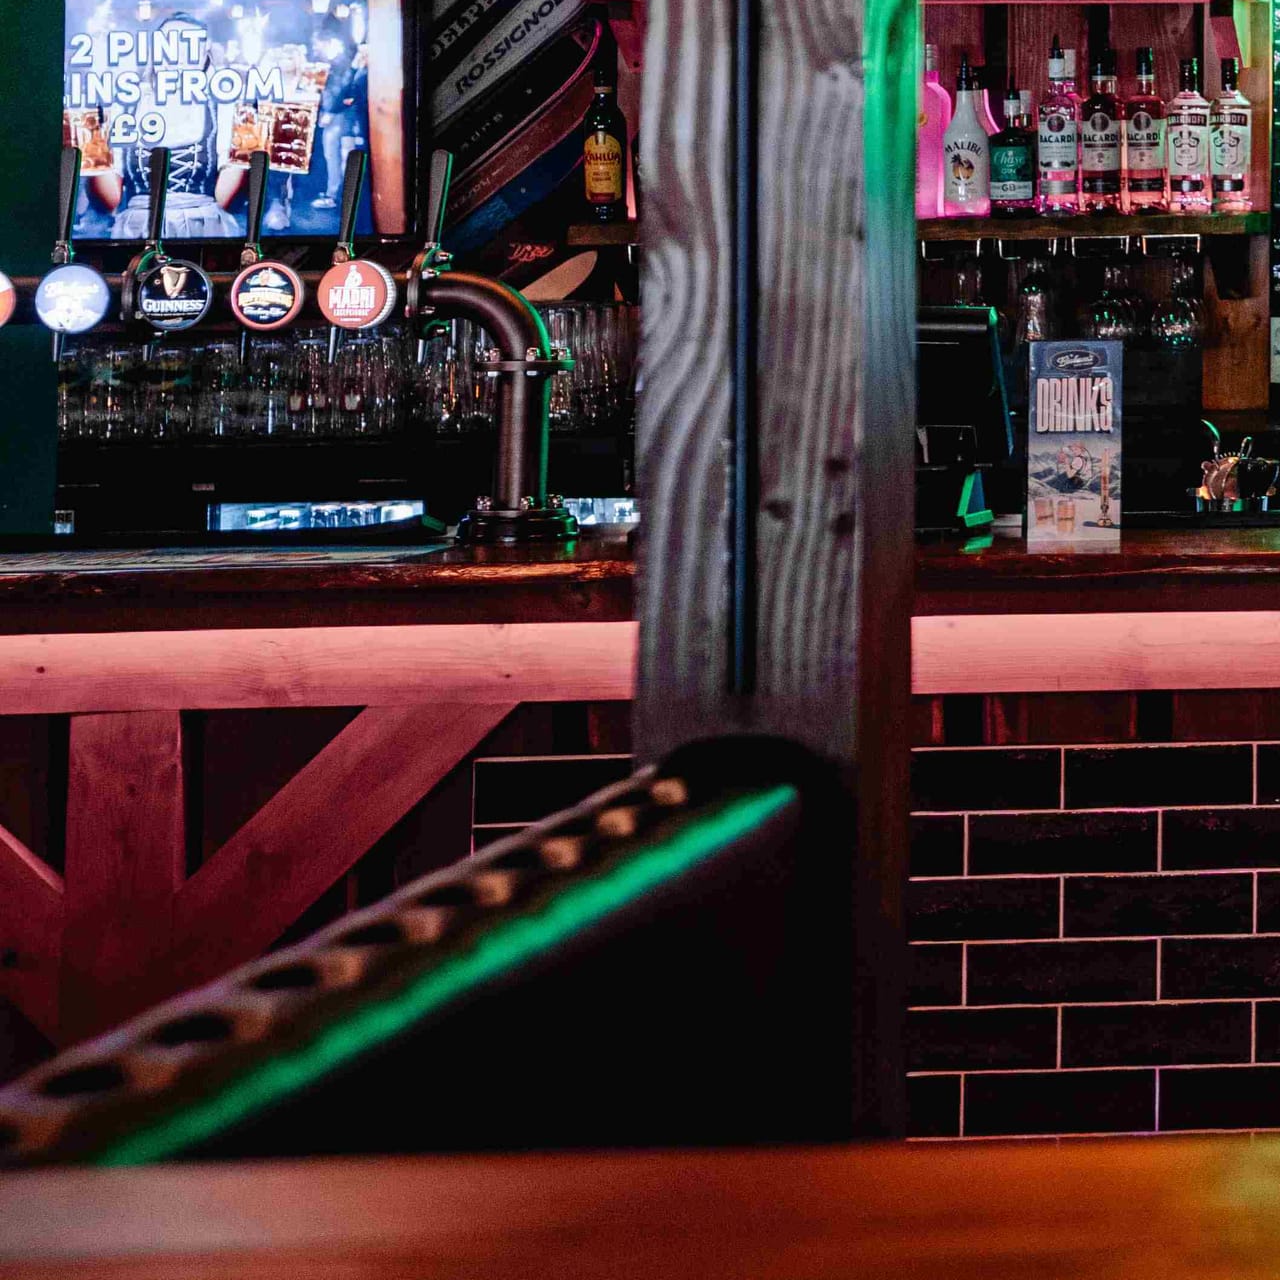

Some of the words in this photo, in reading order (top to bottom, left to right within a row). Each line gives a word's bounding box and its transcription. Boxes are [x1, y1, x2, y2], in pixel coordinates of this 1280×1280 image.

[69, 33, 93, 67] 2
[107, 28, 208, 67] PINT
[156, 67, 285, 106] FROM
[109, 112, 166, 145] £9
[945, 141, 983, 156] MALIBU
[142, 298, 207, 314] GUINNESS
[1036, 377, 1114, 432] DRINKS
